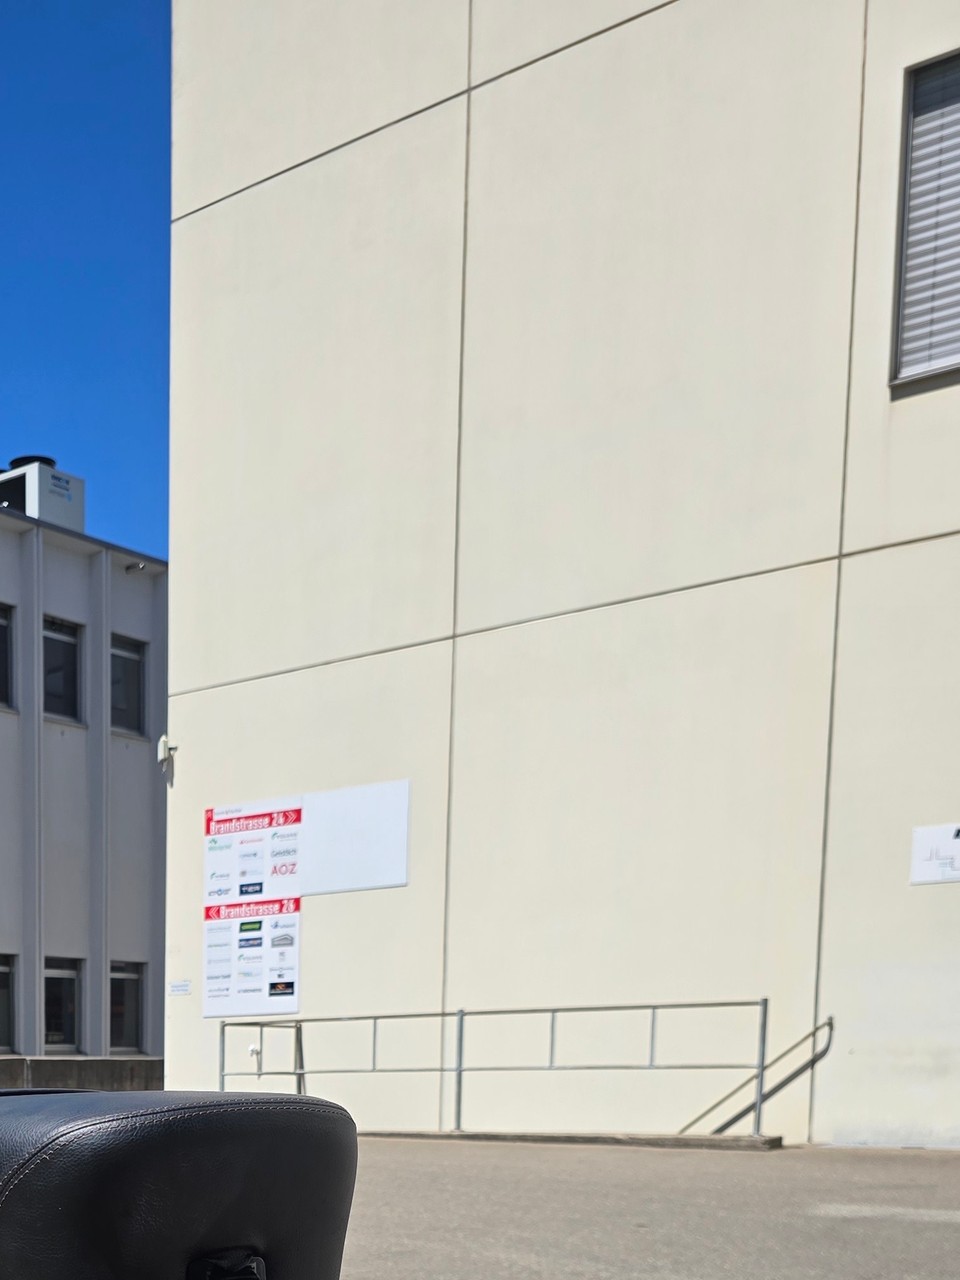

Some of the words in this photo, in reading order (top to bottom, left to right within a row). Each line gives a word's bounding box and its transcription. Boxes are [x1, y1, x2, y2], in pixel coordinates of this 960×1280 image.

[210, 817, 269, 834] Brandstrasse
[271, 863, 297, 876] AOZ
[220, 902, 279, 919] Brandstrasse
